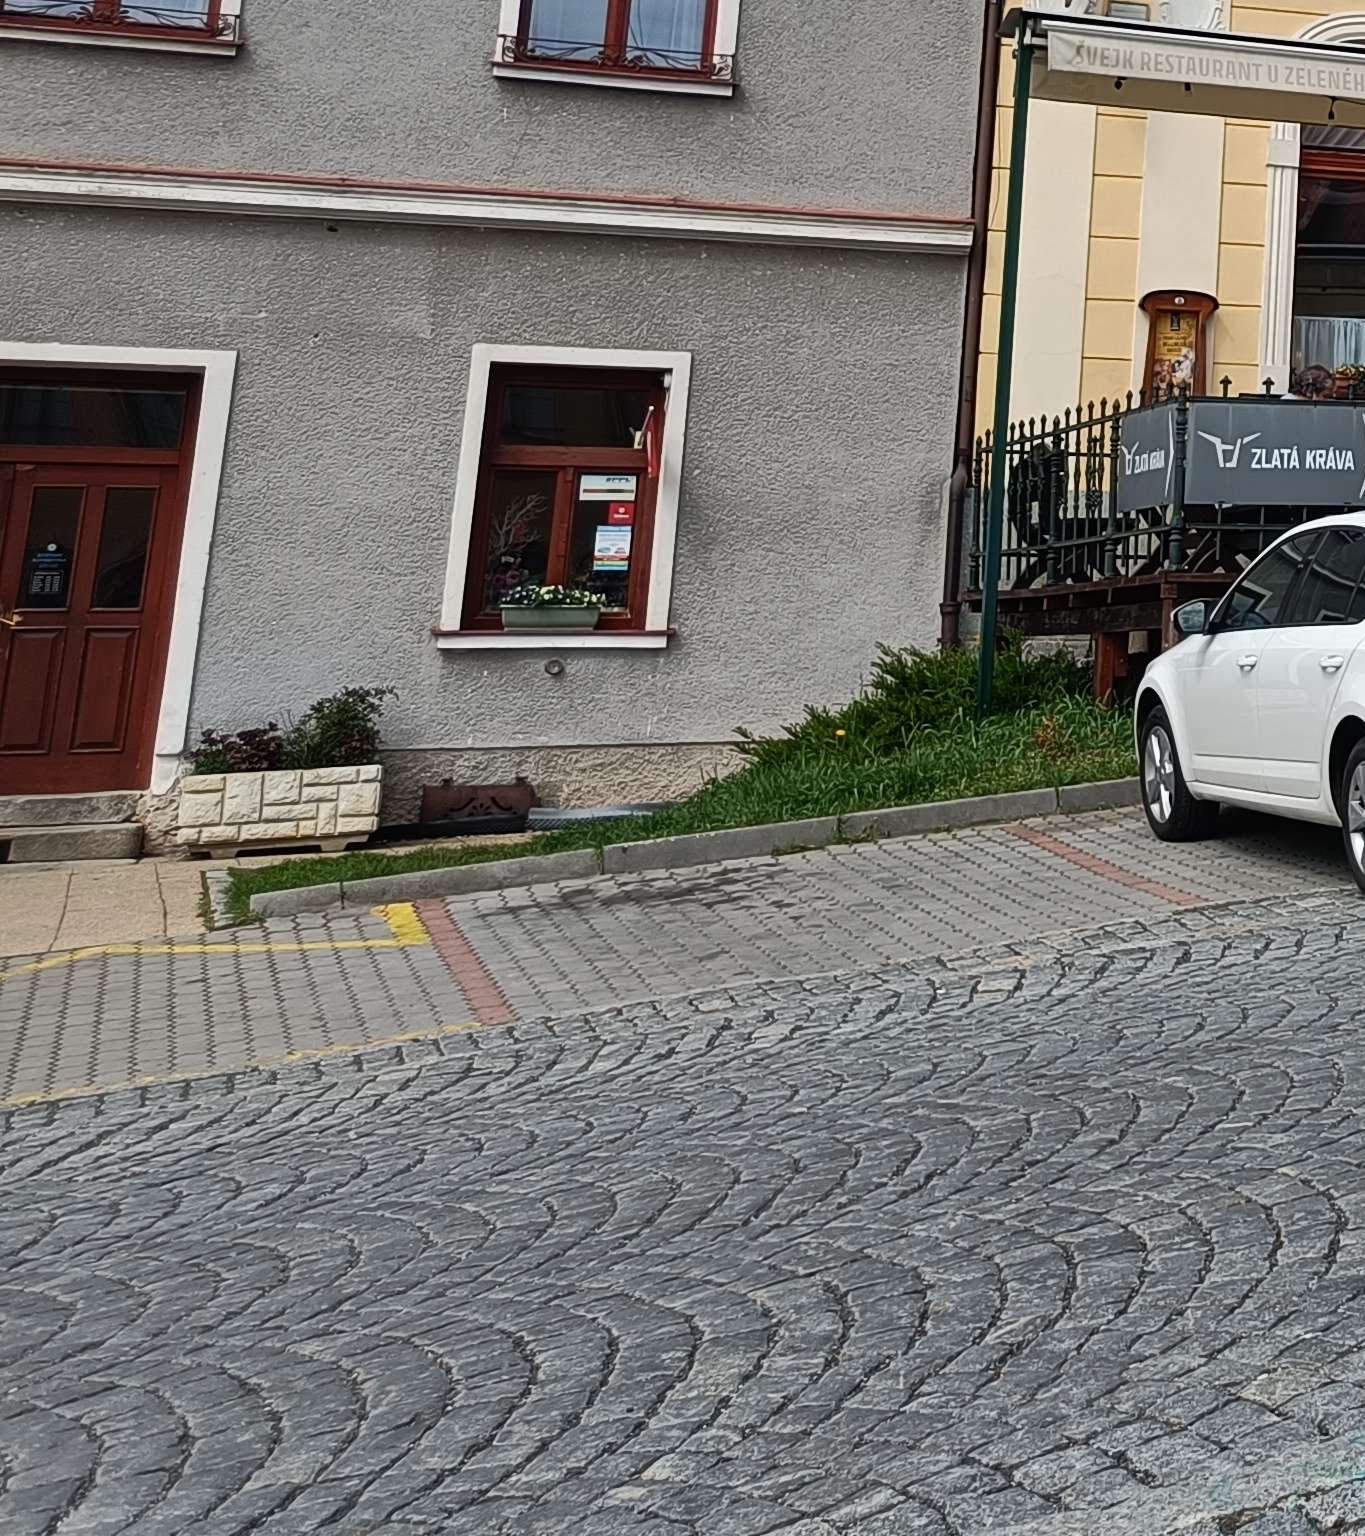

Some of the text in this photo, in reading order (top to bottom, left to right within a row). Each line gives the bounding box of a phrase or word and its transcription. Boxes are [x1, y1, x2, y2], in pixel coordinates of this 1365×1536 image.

[1074, 43, 1134, 69] ŠVEJK
[1140, 52, 1263, 82] RESTAURANT
[1268, 66, 1279, 83] U
[1250, 445, 1355, 471] ZLATÁ KRÁVA
